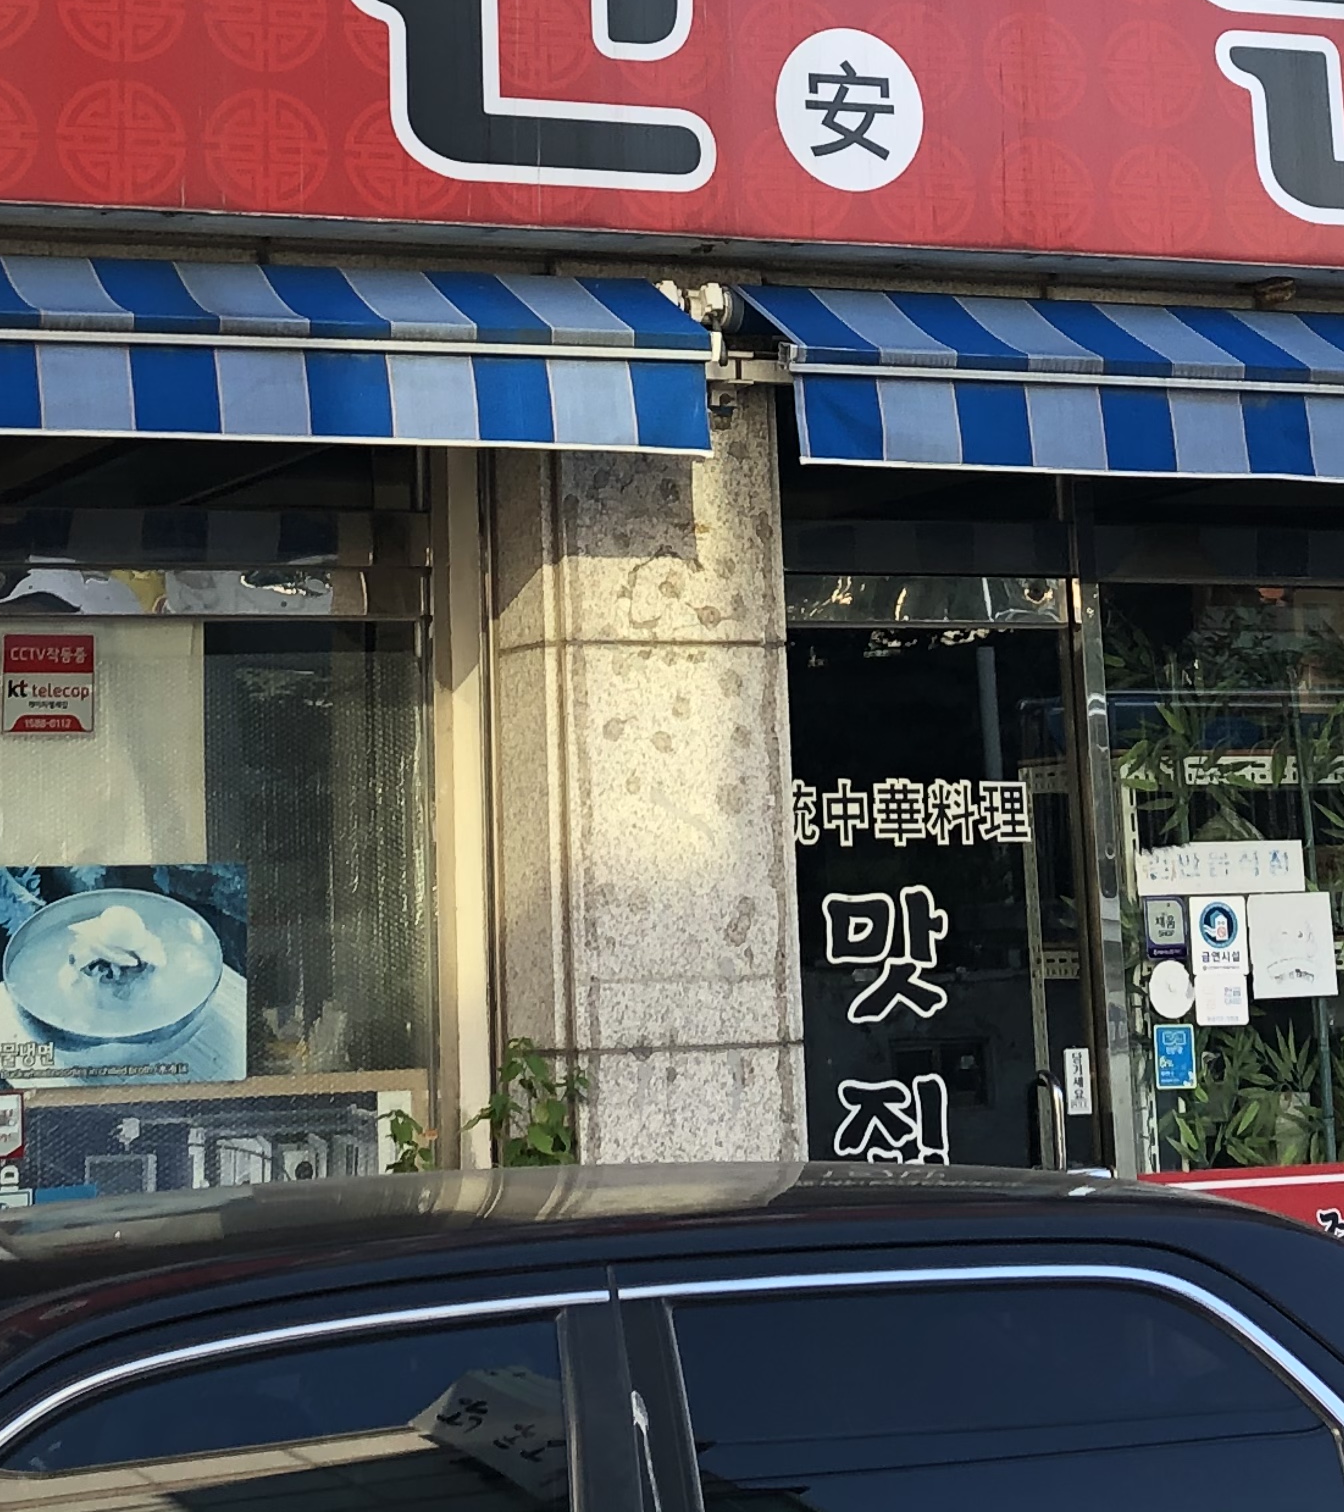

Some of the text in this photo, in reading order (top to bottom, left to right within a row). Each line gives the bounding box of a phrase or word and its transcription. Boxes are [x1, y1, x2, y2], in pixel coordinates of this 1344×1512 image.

[32, 682, 90, 701] telecop
[1201, 951, 1241, 963] 금연시설
[0, 1042, 55, 1068] 물냉면
